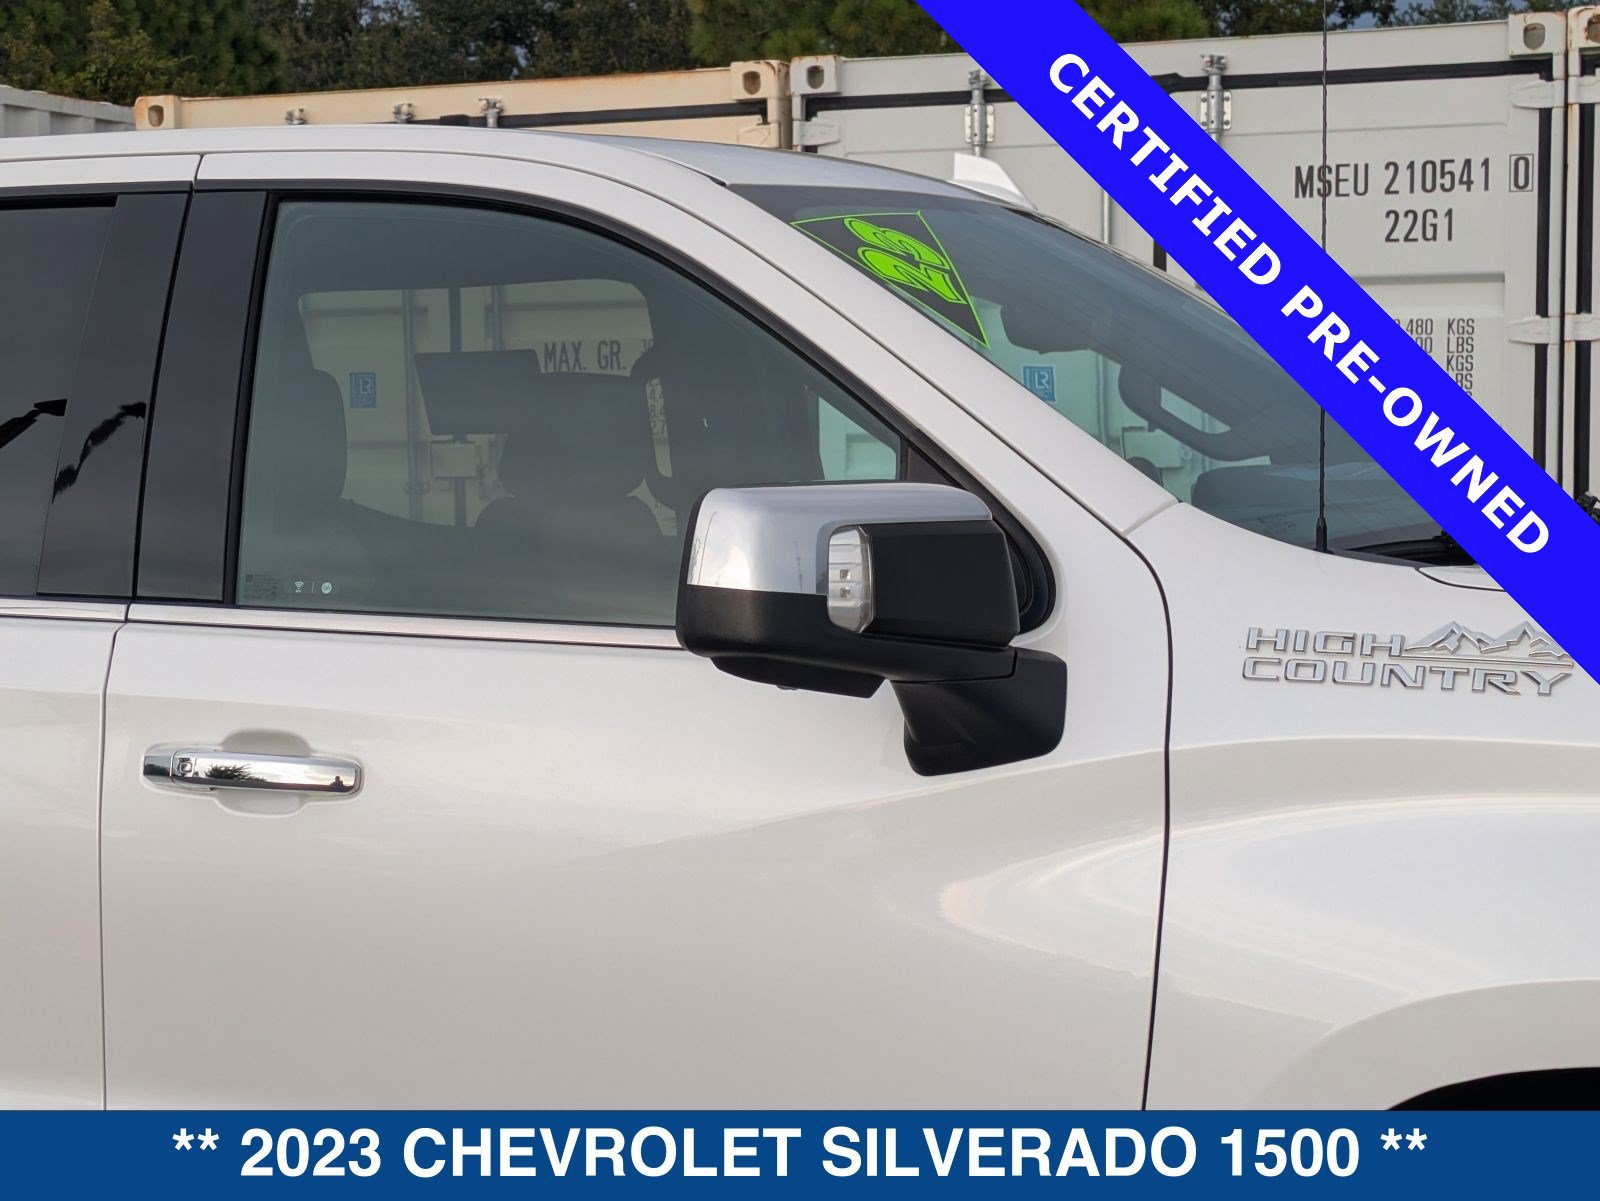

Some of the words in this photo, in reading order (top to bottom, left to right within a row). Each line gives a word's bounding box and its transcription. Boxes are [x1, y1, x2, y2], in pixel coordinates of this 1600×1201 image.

[1294, 163, 1370, 199] MSEU
[1383, 157, 1491, 195] 210541
[1512, 155, 1531, 191] 0
[1384, 208, 1454, 243] 22G1
[1446, 317, 1475, 336] KGS
[543, 341, 588, 372] MAX.
[596, 339, 627, 371] GR.
[1446, 335, 1474, 354] LBS
[1446, 354, 1474, 373] KGS
[1454, 372, 1473, 391] BS
[1245, 626, 1406, 657] HIGH
[1242, 656, 1573, 697] COUNTRY
